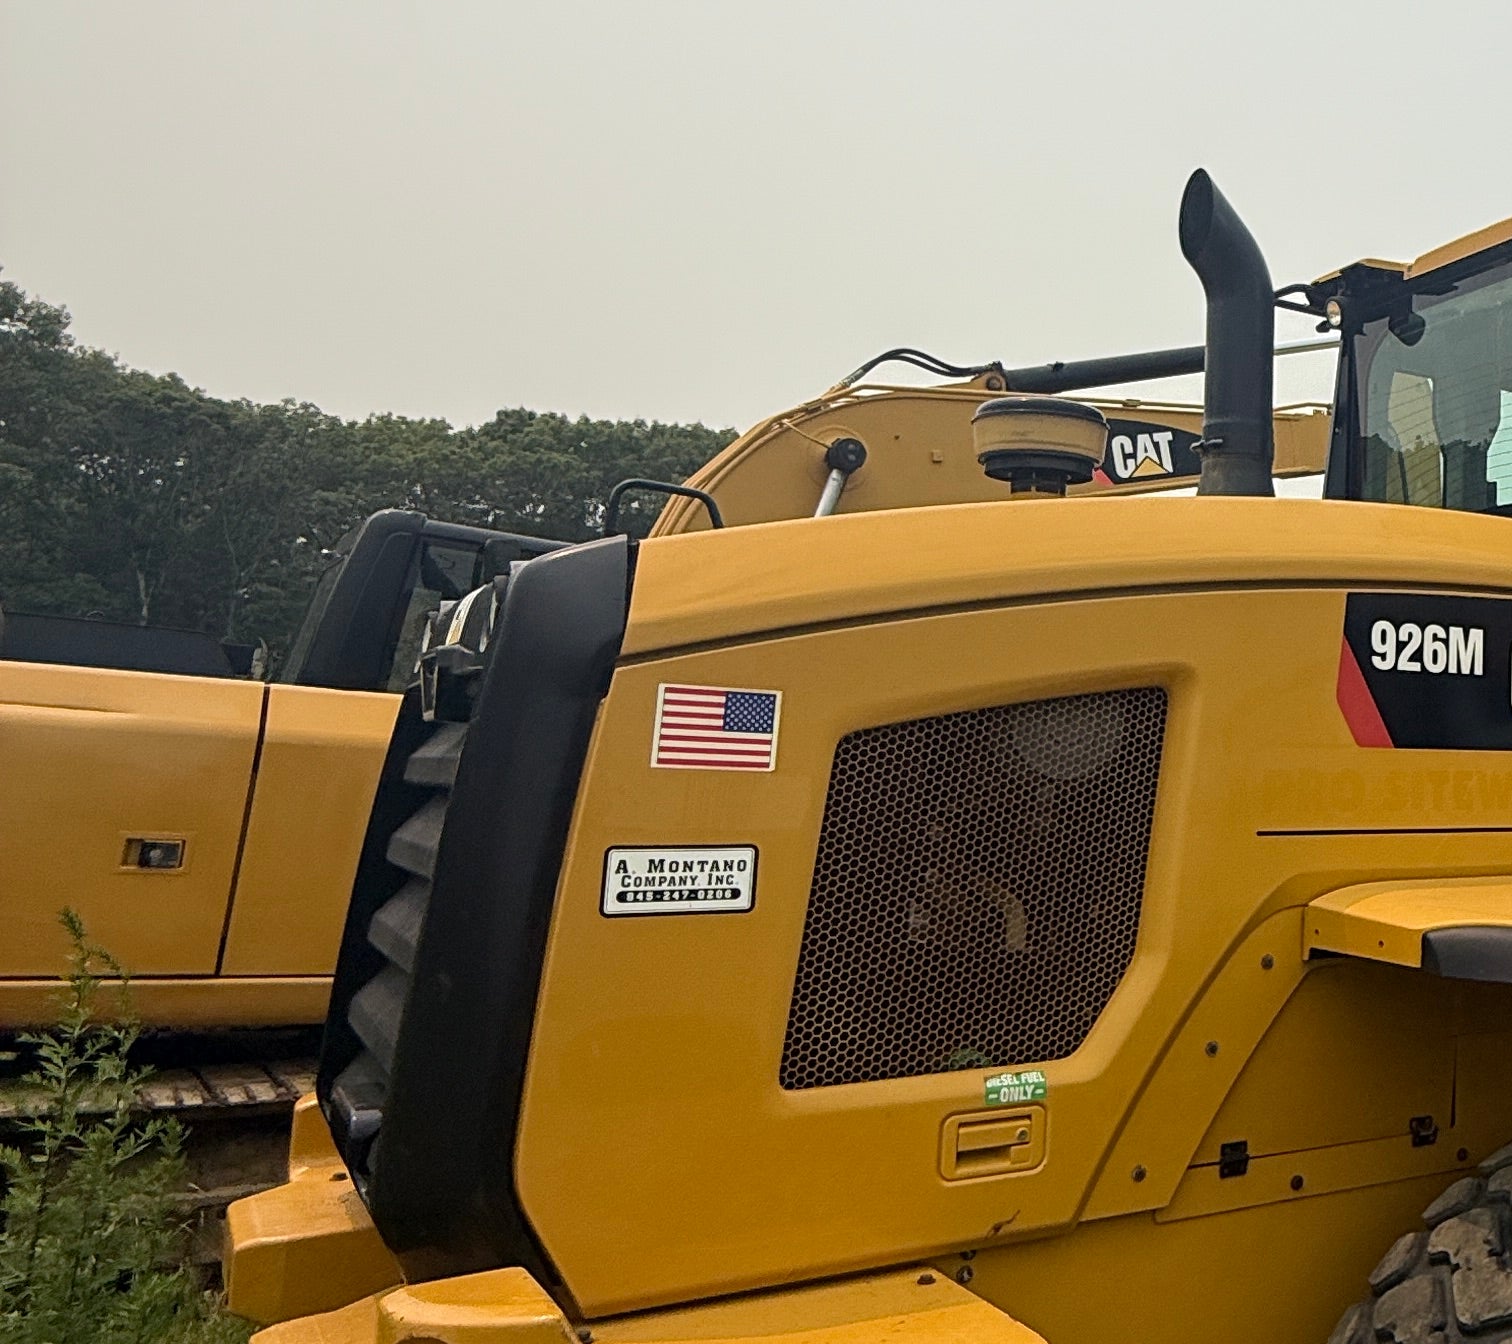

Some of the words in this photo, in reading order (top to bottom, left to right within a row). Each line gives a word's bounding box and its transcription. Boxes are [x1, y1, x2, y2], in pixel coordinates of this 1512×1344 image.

[1111, 431, 1174, 479] CAT
[1371, 620, 1484, 676] 926M
[647, 858, 747, 874] MONTANO
[1020, 1071, 1045, 1084] FUEL
